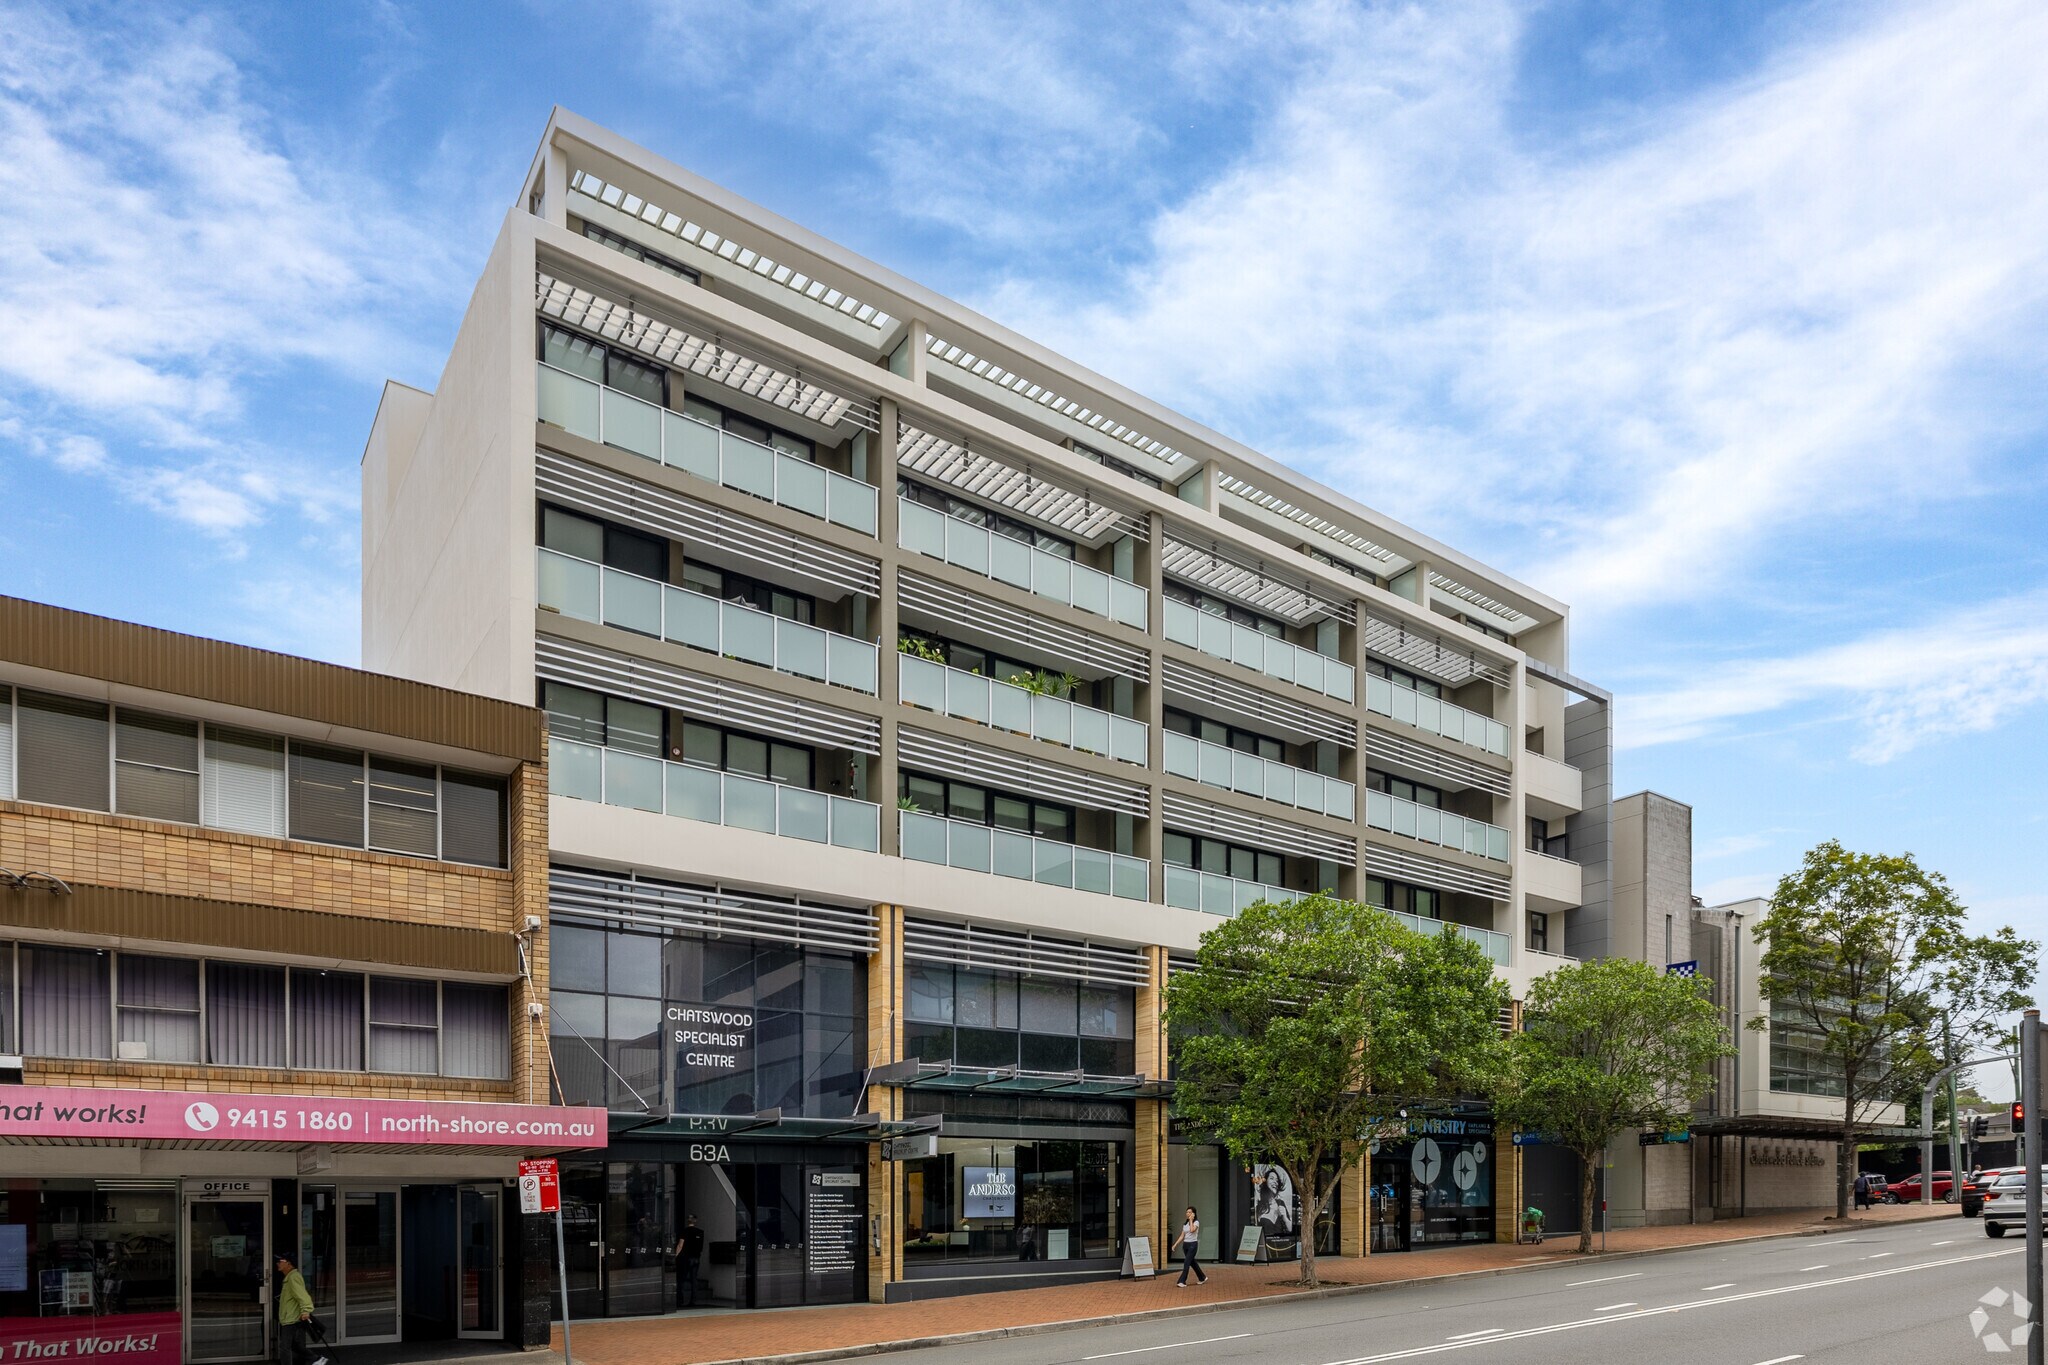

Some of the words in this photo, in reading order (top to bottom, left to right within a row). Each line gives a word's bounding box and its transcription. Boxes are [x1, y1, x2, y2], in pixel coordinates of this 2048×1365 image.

[667, 1008, 752, 1027] CHATSWOOD
[675, 1031, 745, 1047] SPECIALIST
[686, 1053, 735, 1067] CENTRE
[0, 1100, 44, 1121] hat
[53, 1104, 146, 1124] works!
[227, 1108, 287, 1129] 9415
[297, 1110, 353, 1131] 1860
[382, 1115, 595, 1136] north-shore.com.au
[1410, 1119, 1467, 1135] DNTISTRY
[690, 1144, 730, 1162] 63A
[203, 1182, 251, 1191] OFFICE
[987, 1173, 1006, 1184] THE
[968, 1184, 1016, 1196] ANDERSO
[12, 1339, 69, 1359] That
[76, 1334, 158, 1356] Works!
